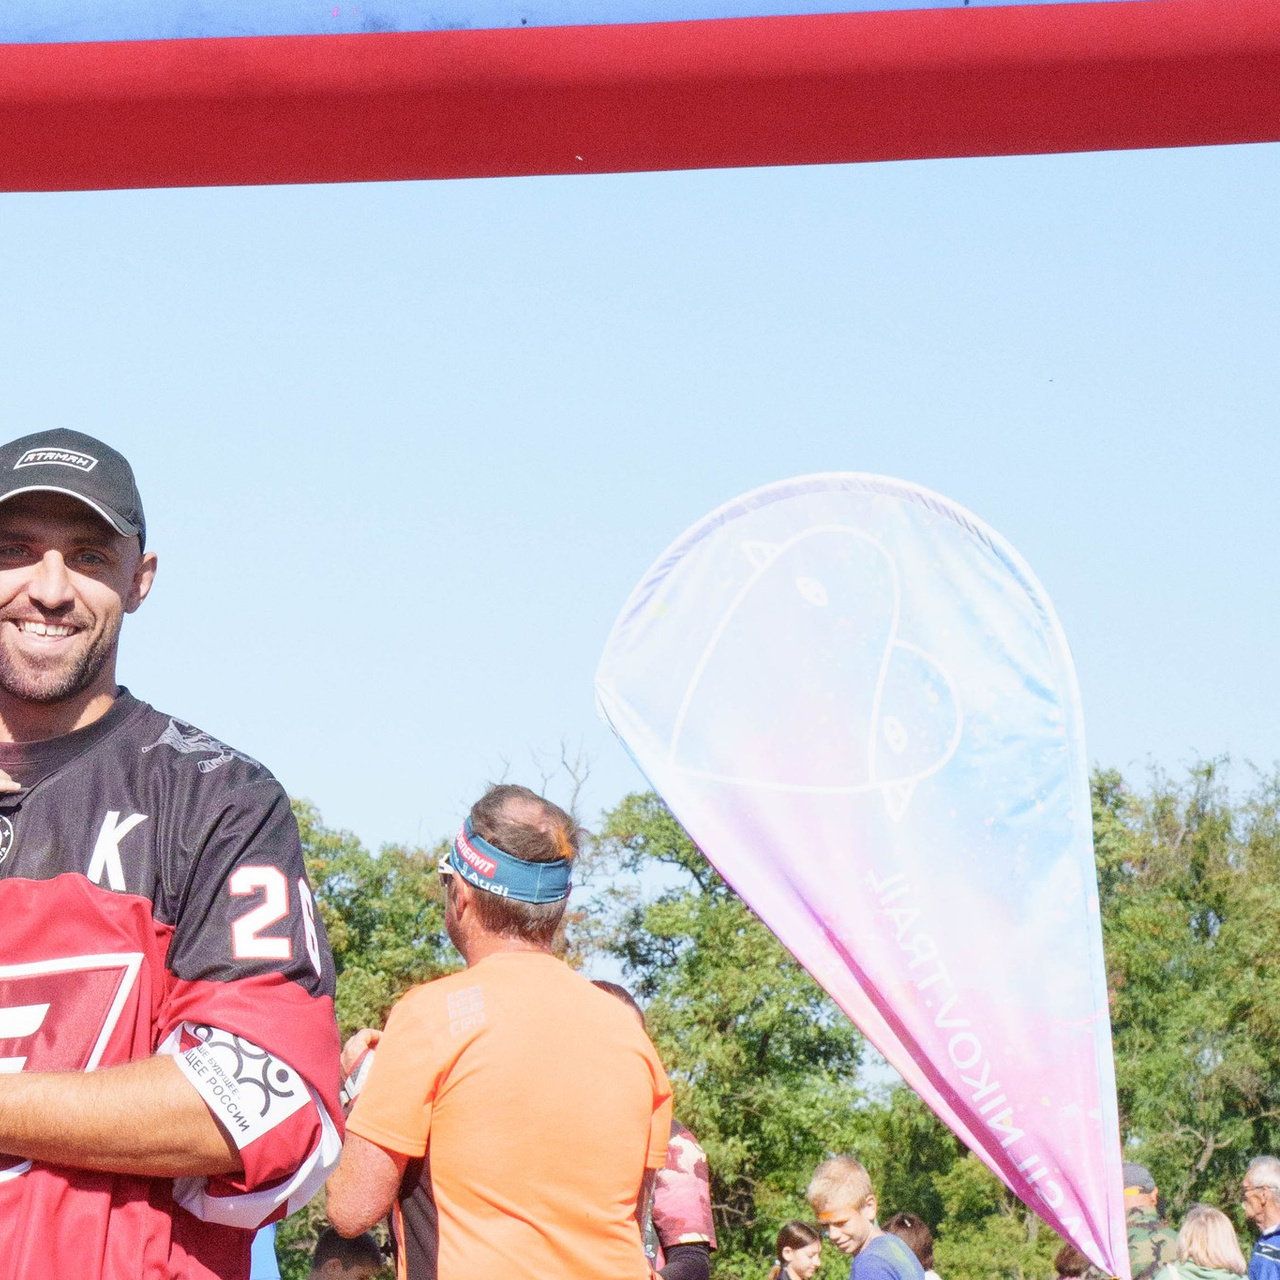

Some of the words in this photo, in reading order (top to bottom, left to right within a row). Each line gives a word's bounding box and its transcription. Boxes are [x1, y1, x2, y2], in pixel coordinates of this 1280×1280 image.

[467, 871, 510, 897] Audi
[207, 1057, 239, 1096] БУДУЩЕЕ
[205, 1076, 251, 1133] РОССИИ
